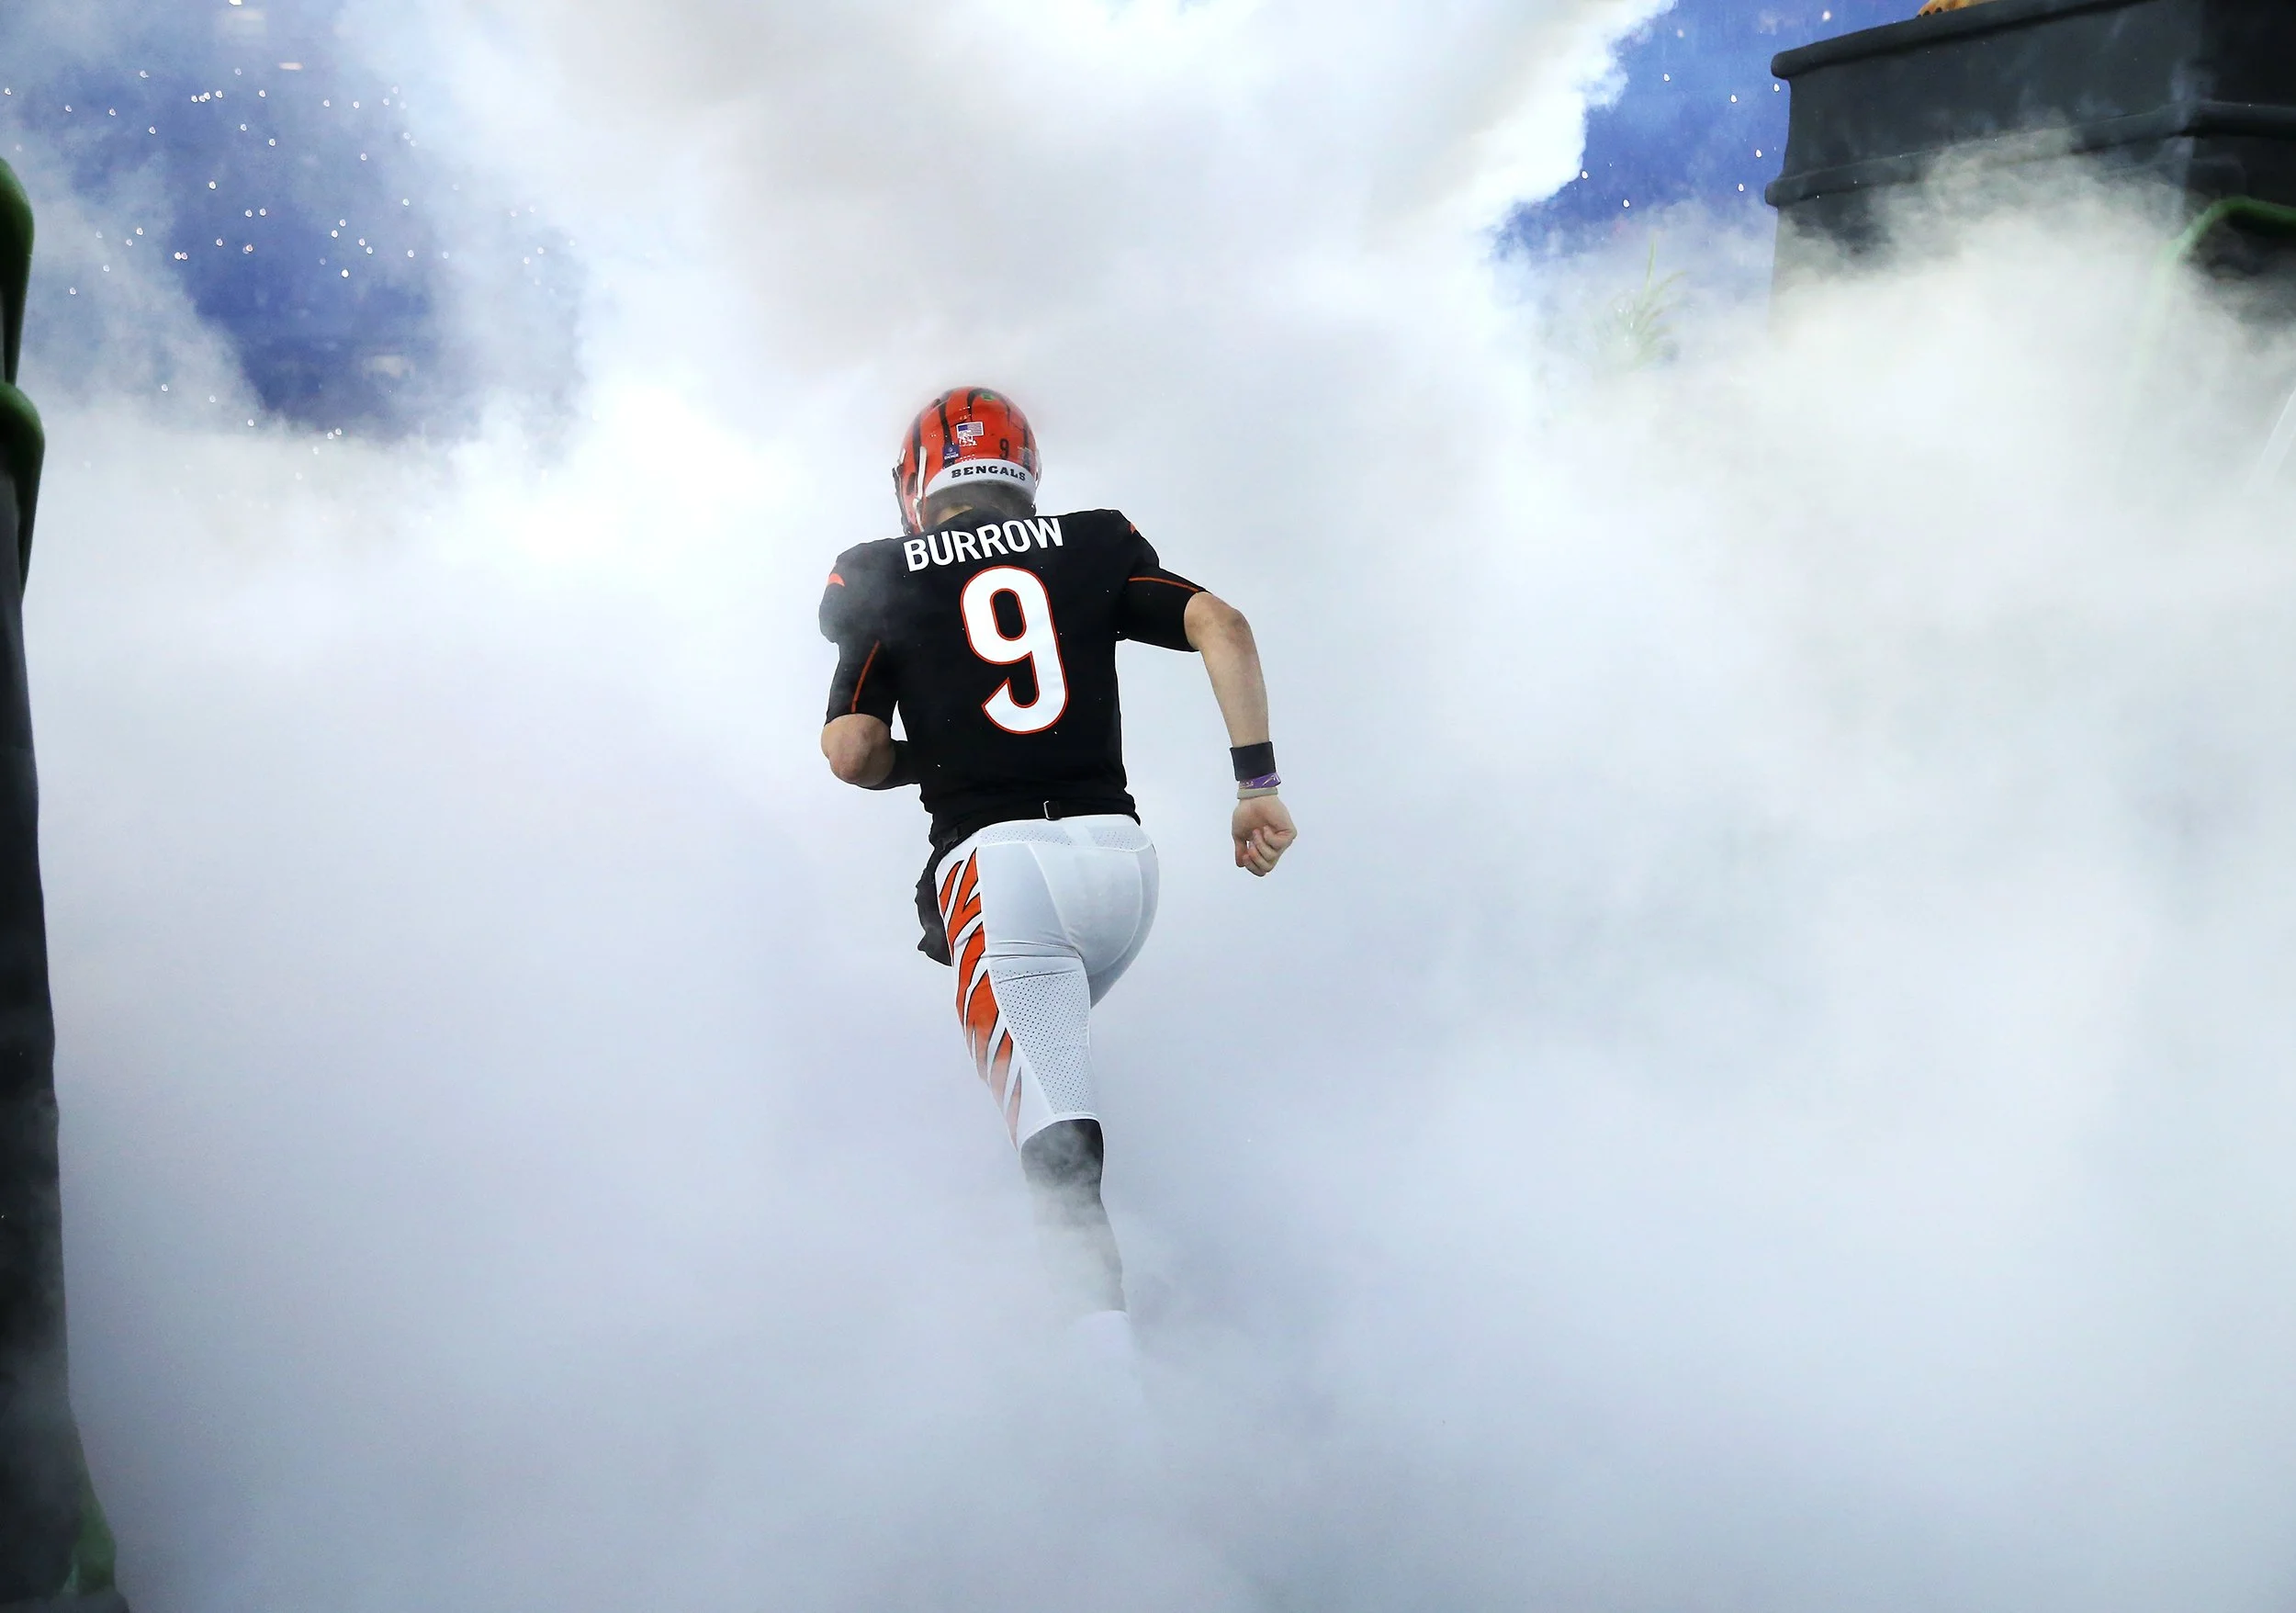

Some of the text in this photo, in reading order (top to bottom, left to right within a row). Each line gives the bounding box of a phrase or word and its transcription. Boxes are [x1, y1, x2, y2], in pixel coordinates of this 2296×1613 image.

[999, 438, 1009, 460] 9
[951, 465, 1026, 481] BENGALS
[903, 517, 1064, 572] BURROW
[960, 565, 1069, 735] 9
